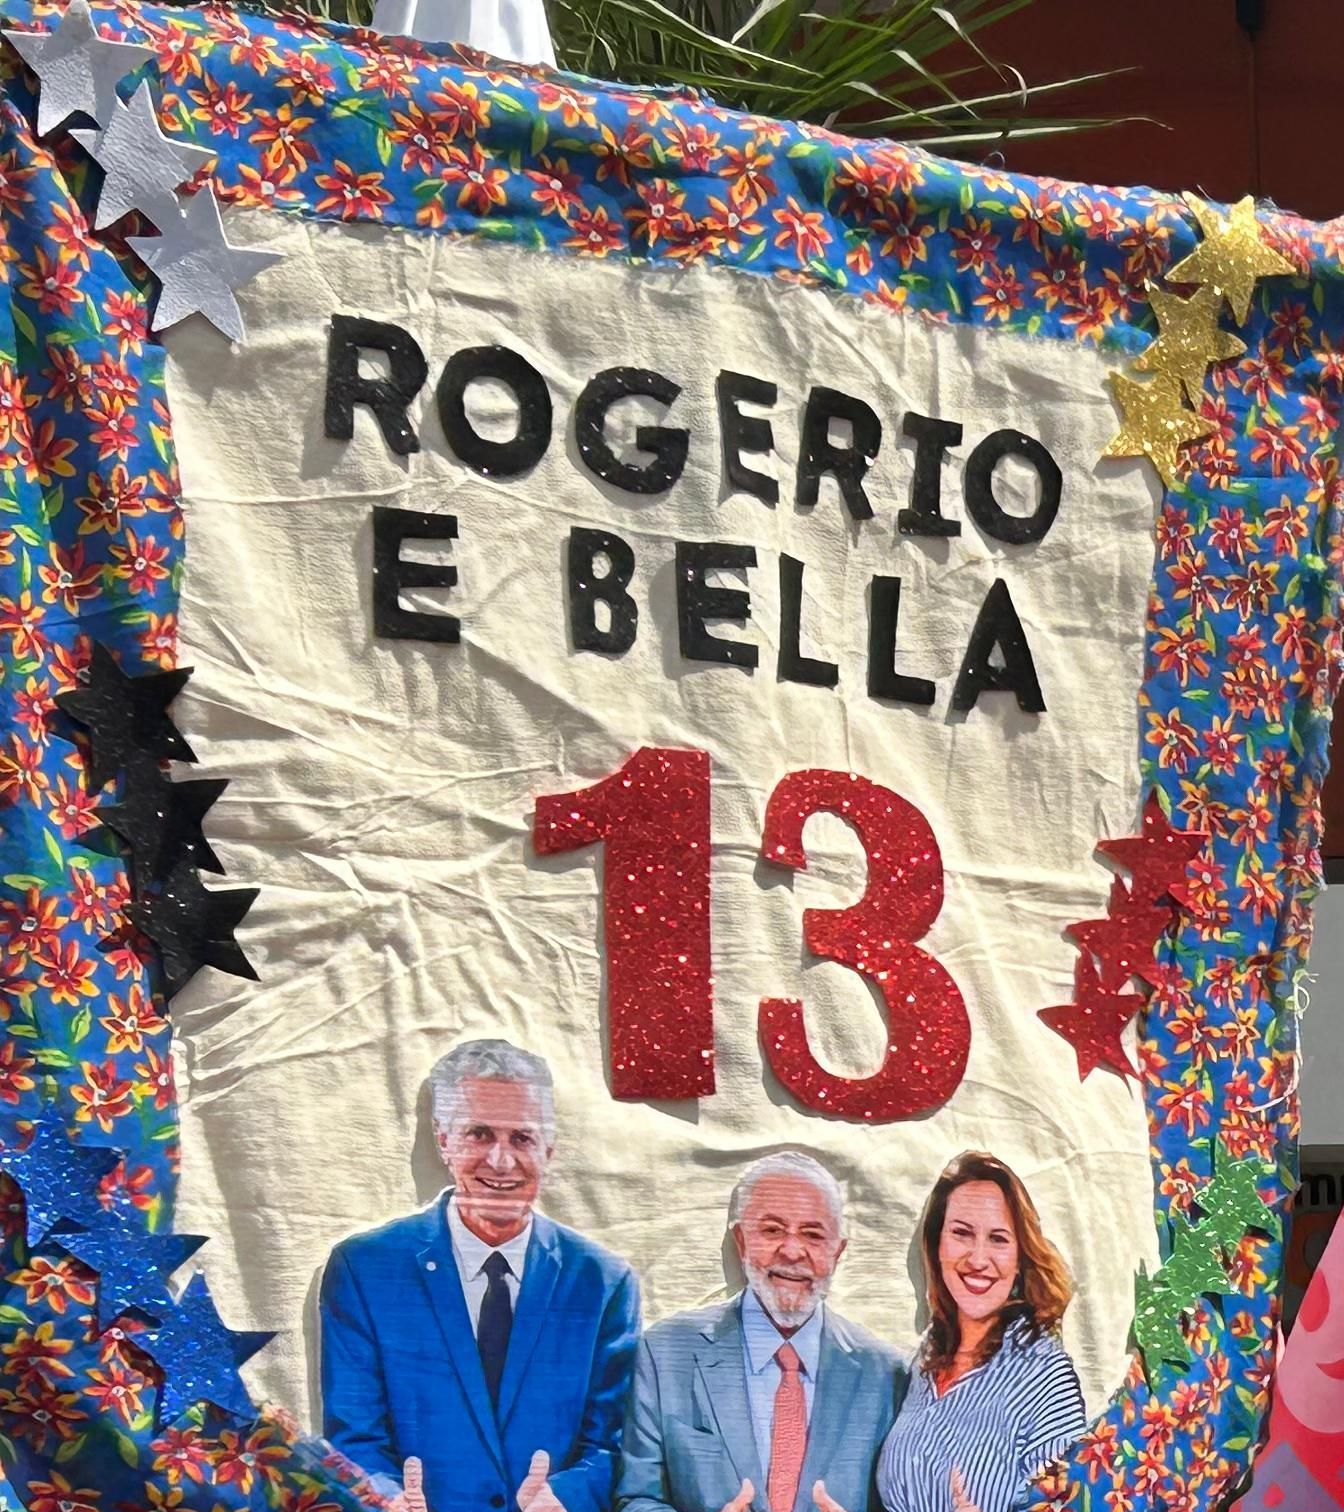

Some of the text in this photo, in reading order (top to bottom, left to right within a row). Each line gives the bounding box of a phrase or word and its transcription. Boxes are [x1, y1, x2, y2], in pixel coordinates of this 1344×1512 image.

[323, 313, 1063, 546] ROGERIO
[371, 505, 1047, 713] E BELLA
[533, 745, 973, 1124] 13
